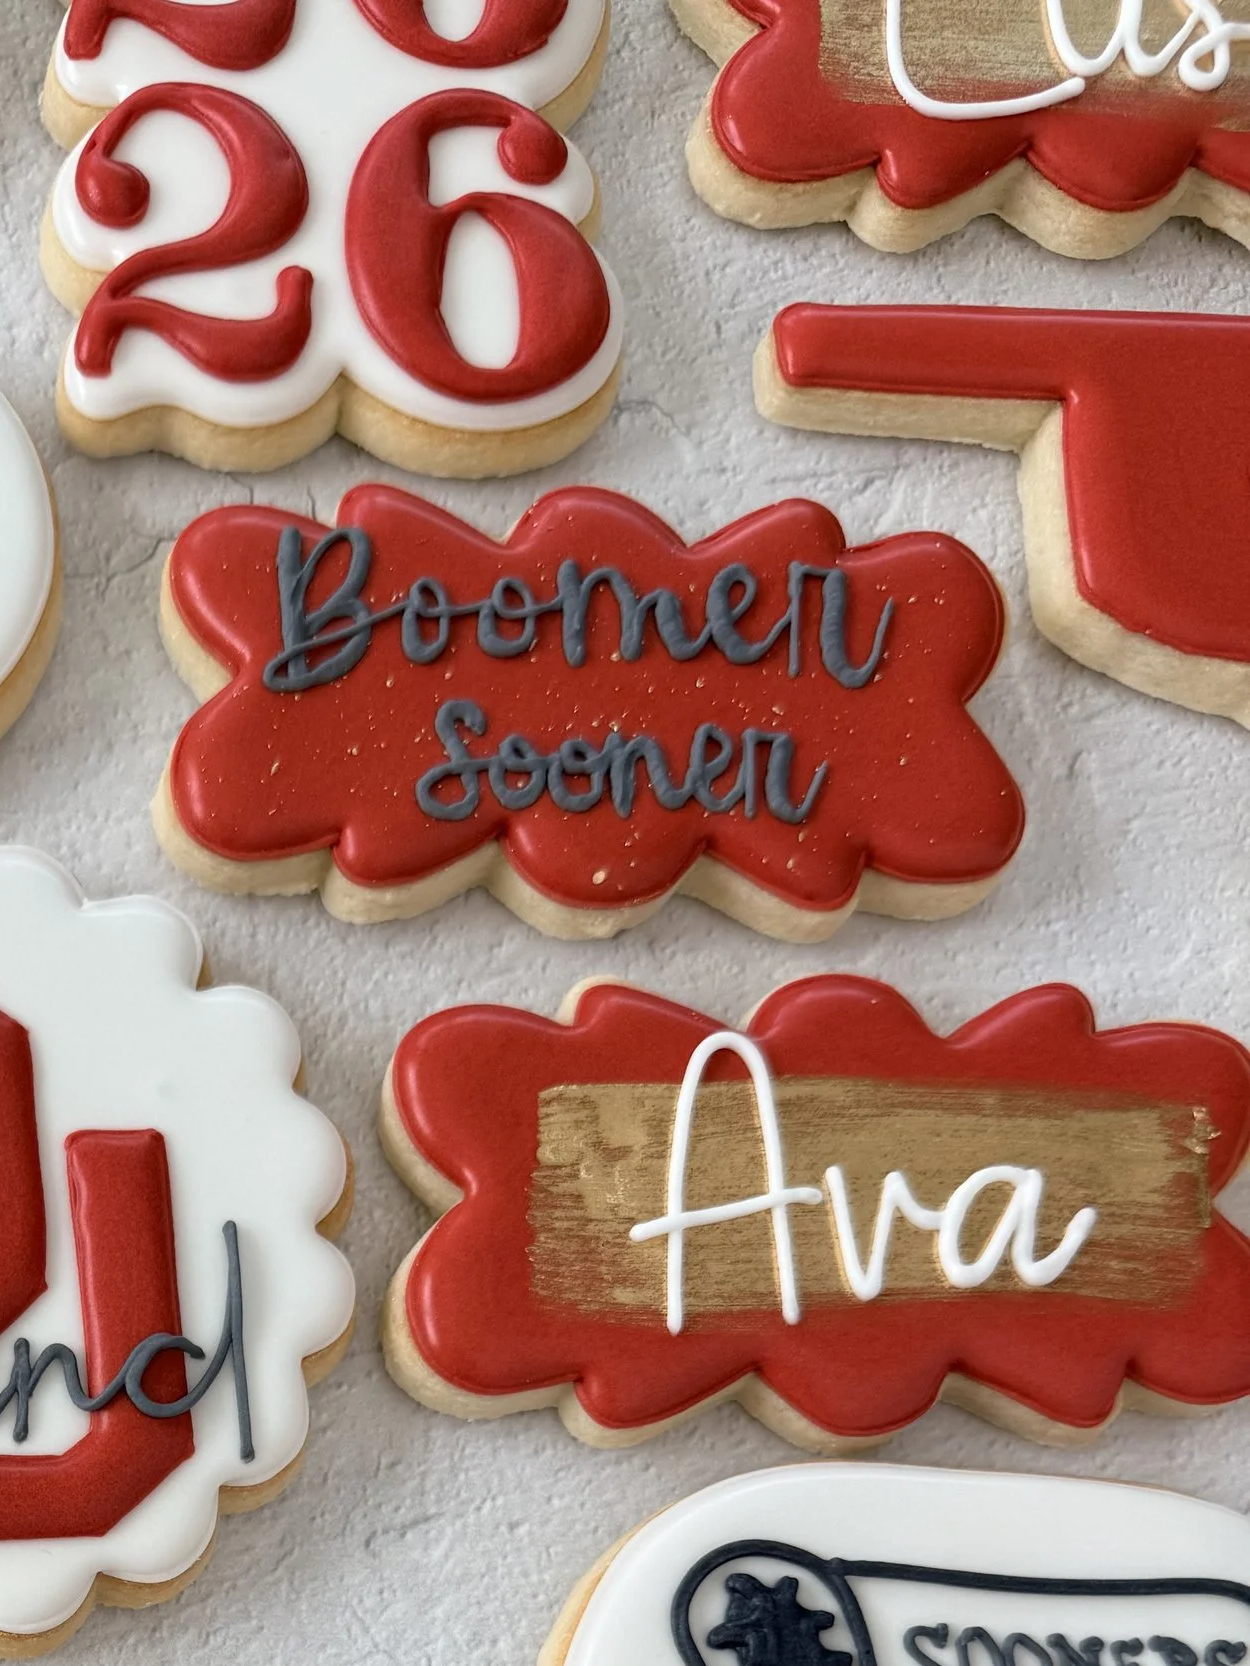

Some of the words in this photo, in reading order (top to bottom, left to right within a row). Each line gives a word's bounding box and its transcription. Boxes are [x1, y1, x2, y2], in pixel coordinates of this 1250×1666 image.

[75, 82, 609, 405] 26
[263, 525, 895, 691] Boomer
[629, 1030, 1097, 1335] Ava
